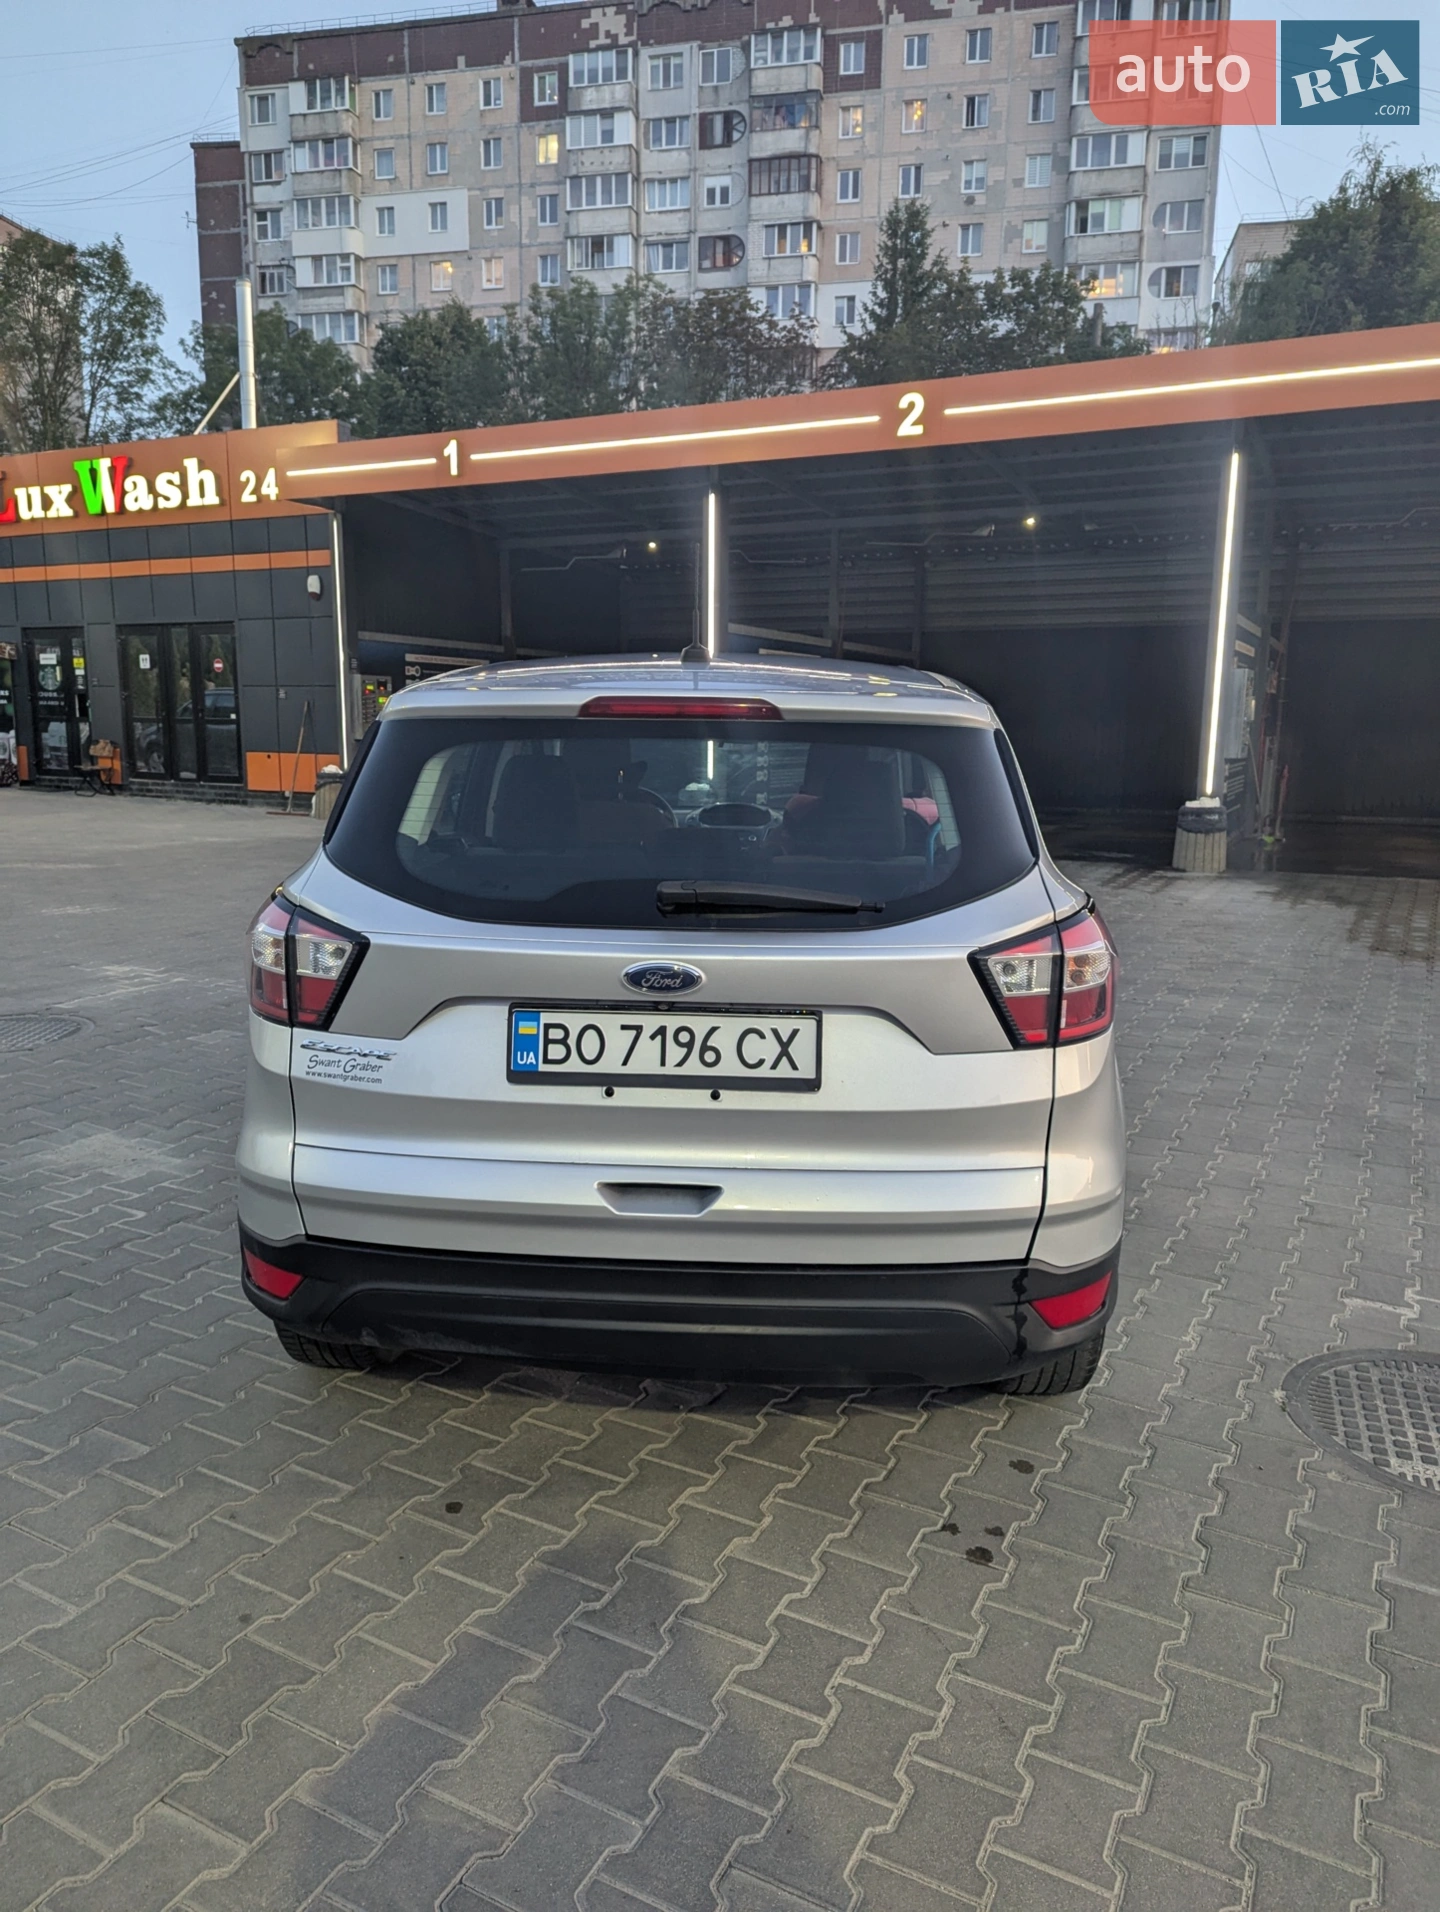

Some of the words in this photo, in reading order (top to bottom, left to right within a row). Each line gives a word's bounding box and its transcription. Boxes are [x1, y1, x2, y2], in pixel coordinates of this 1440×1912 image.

[897, 391, 925, 437] 2
[443, 438, 458, 476] 1
[239, 467, 279, 503] 24
[641, 969, 683, 988] Ford
[517, 1051, 536, 1065] UA
[542, 1022, 606, 1066] BO
[619, 1024, 722, 1068] 7196
[736, 1026, 801, 1071] CX
[305, 1070, 382, 1084] www.swantgraber.com
[307, 1054, 342, 1070] Swant
[343, 1058, 383, 1073] Graber
